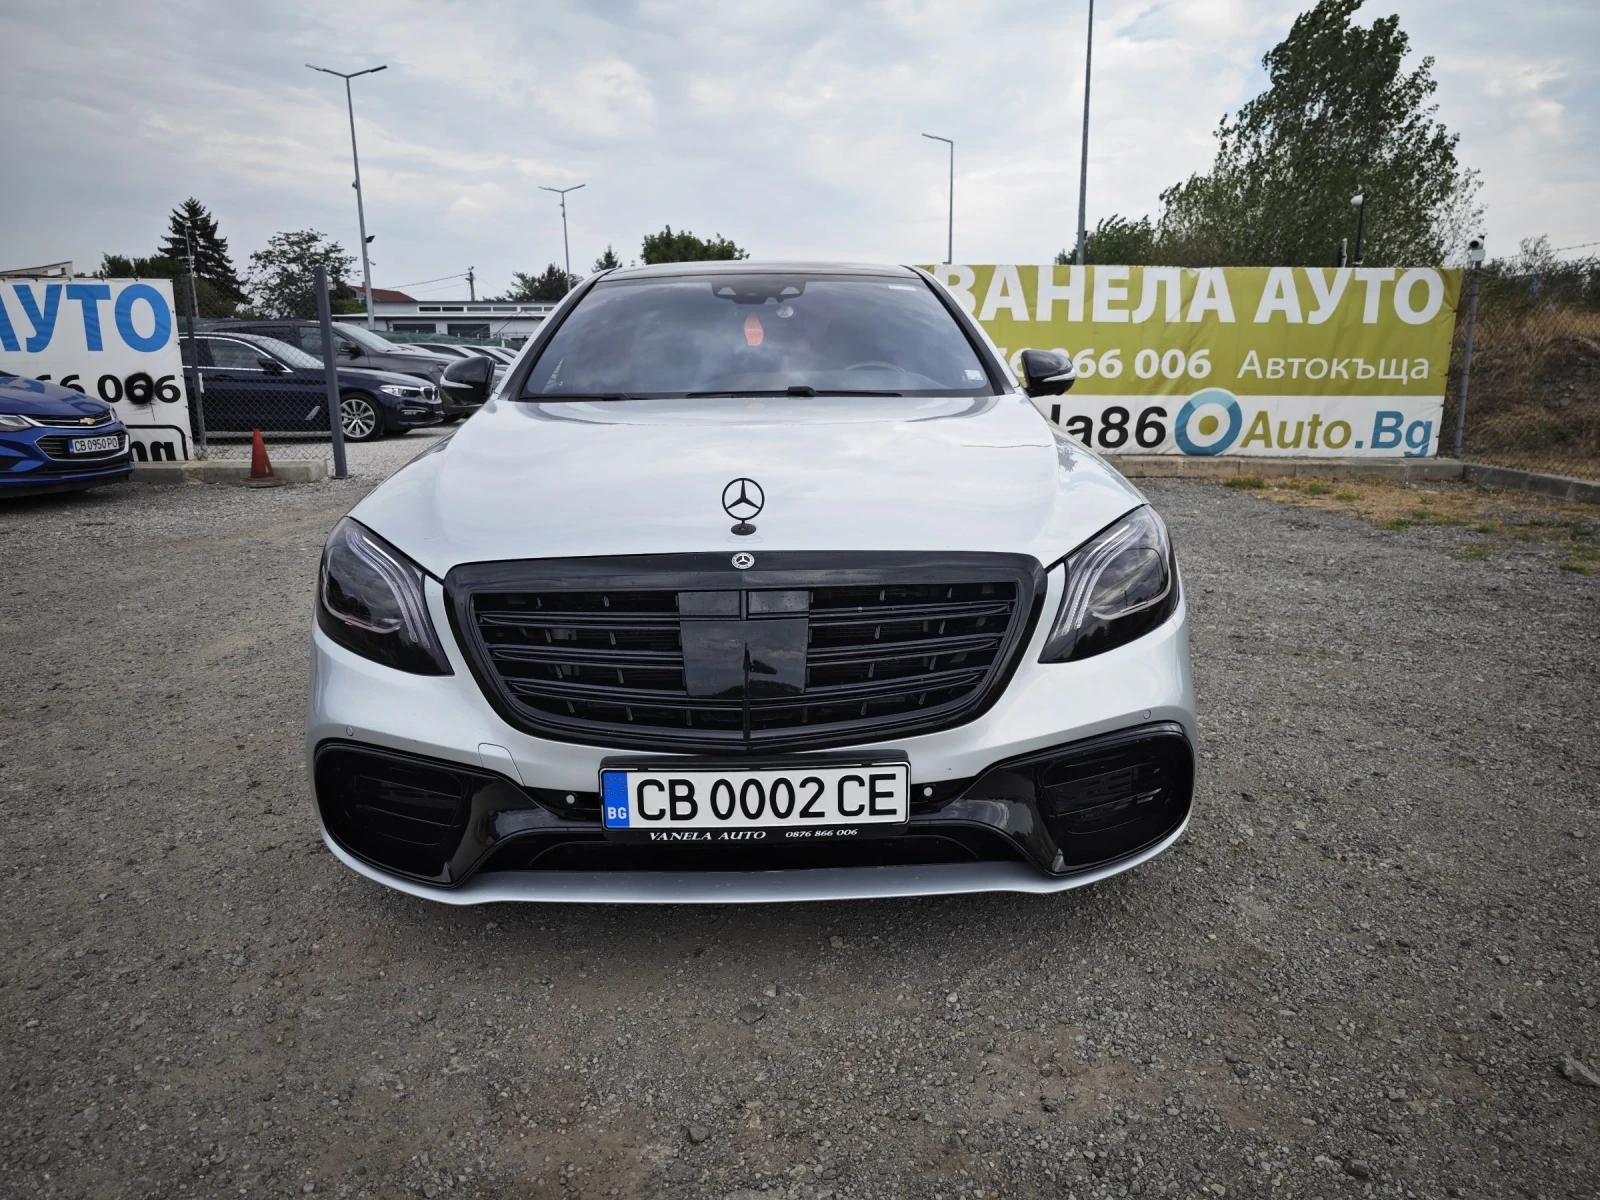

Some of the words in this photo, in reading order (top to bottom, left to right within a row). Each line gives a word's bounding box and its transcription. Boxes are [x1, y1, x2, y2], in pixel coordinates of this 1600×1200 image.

[934, 265, 1235, 323] ВАНЕЛА
[1254, 267, 1445, 325] АУТО
[1050, 348, 1124, 379] 66
[1134, 348, 1212, 379] 006
[1237, 350, 1430, 385] Автокъща
[607, 806, 627, 820] BG
[637, 778, 698, 821] CB
[710, 776, 825, 821] 0002
[837, 773, 898, 817] CE
[650, 831, 712, 841] VANELA
[718, 831, 766, 840] AUTO
[814, 829, 834, 837] 866
[836, 828, 858, 836] 006
